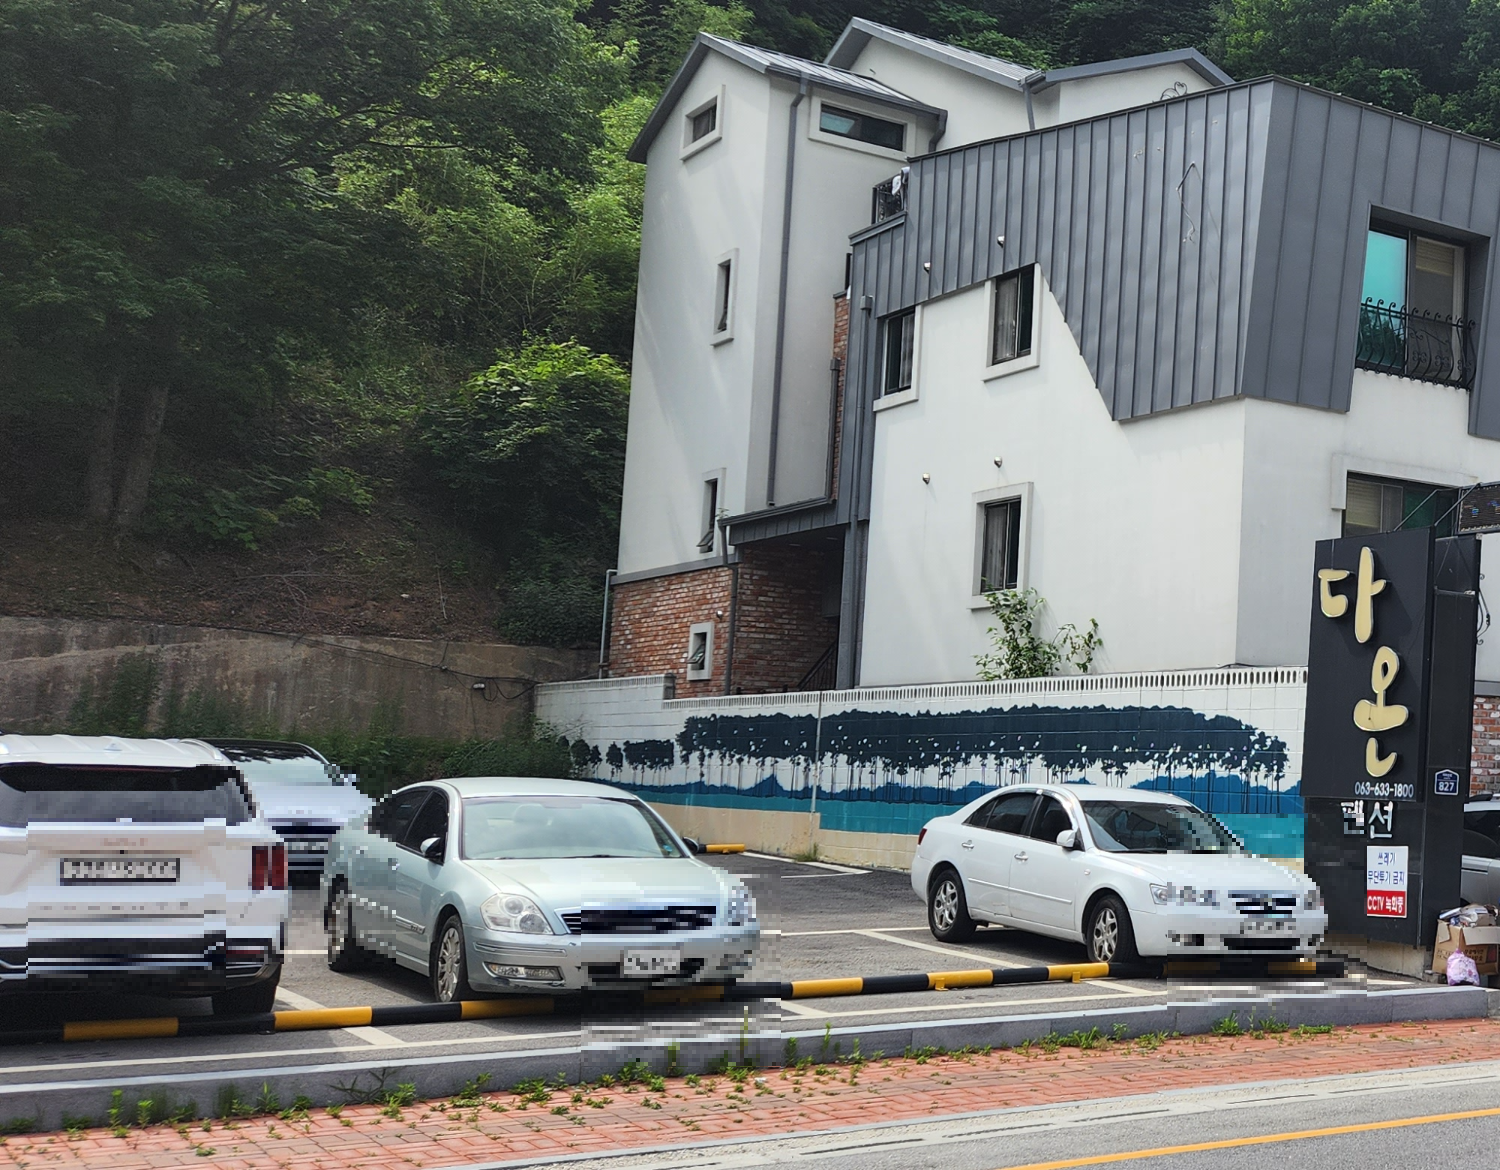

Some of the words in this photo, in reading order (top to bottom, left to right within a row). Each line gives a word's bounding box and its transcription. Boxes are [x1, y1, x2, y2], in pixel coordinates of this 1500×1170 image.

[1318, 546, 1409, 777] 다온
[1354, 781, 1414, 798] 063-633-1800
[1438, 781, 1455, 792] 827
[1377, 852, 1396, 866] 쓰레기
[1367, 870, 1391, 885] 무단투기
[1393, 870, 1405, 885] 금지
[1367, 896, 1385, 911] CCTV
[1385, 896, 1404, 913] 녹화중
